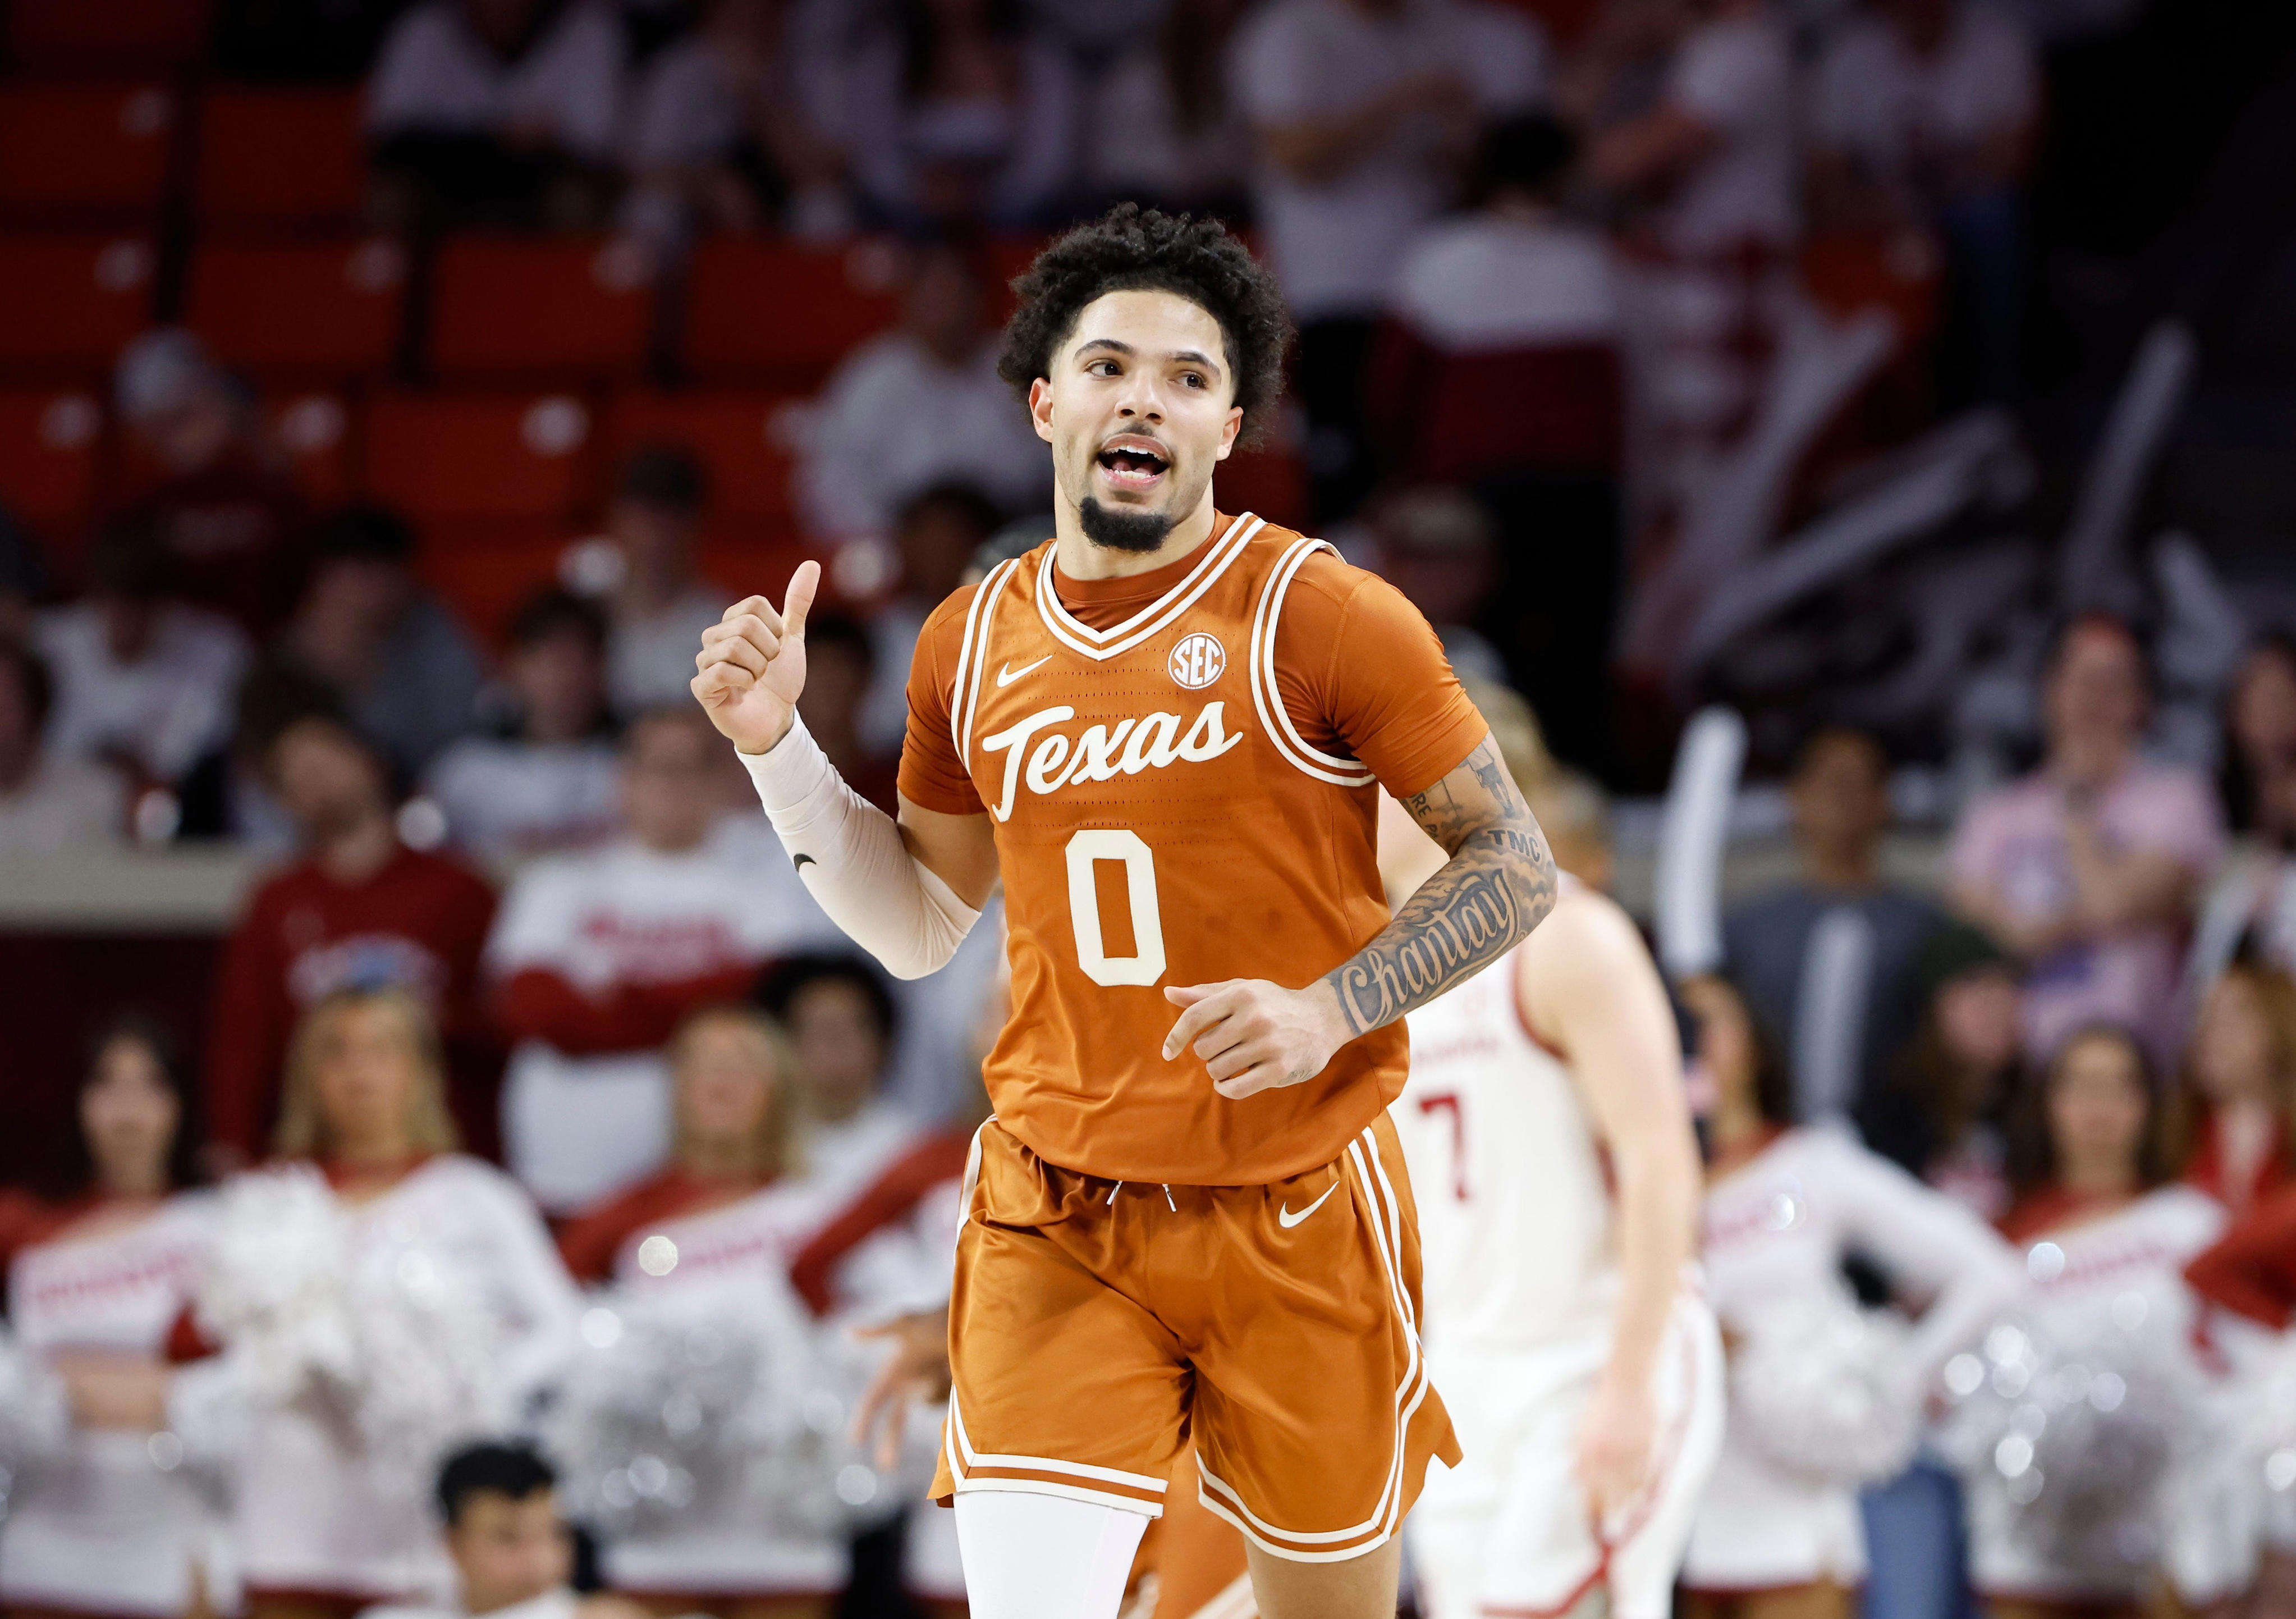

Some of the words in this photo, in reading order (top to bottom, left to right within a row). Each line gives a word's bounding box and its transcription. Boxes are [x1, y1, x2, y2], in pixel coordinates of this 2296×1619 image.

[1174, 636, 1221, 685] SEC
[982, 701, 1244, 822] Texas
[1409, 792, 1432, 818] RE
[1487, 829, 1541, 862] TMC
[1065, 829, 1167, 987] 0
[1341, 869, 1517, 1035] Chantay
